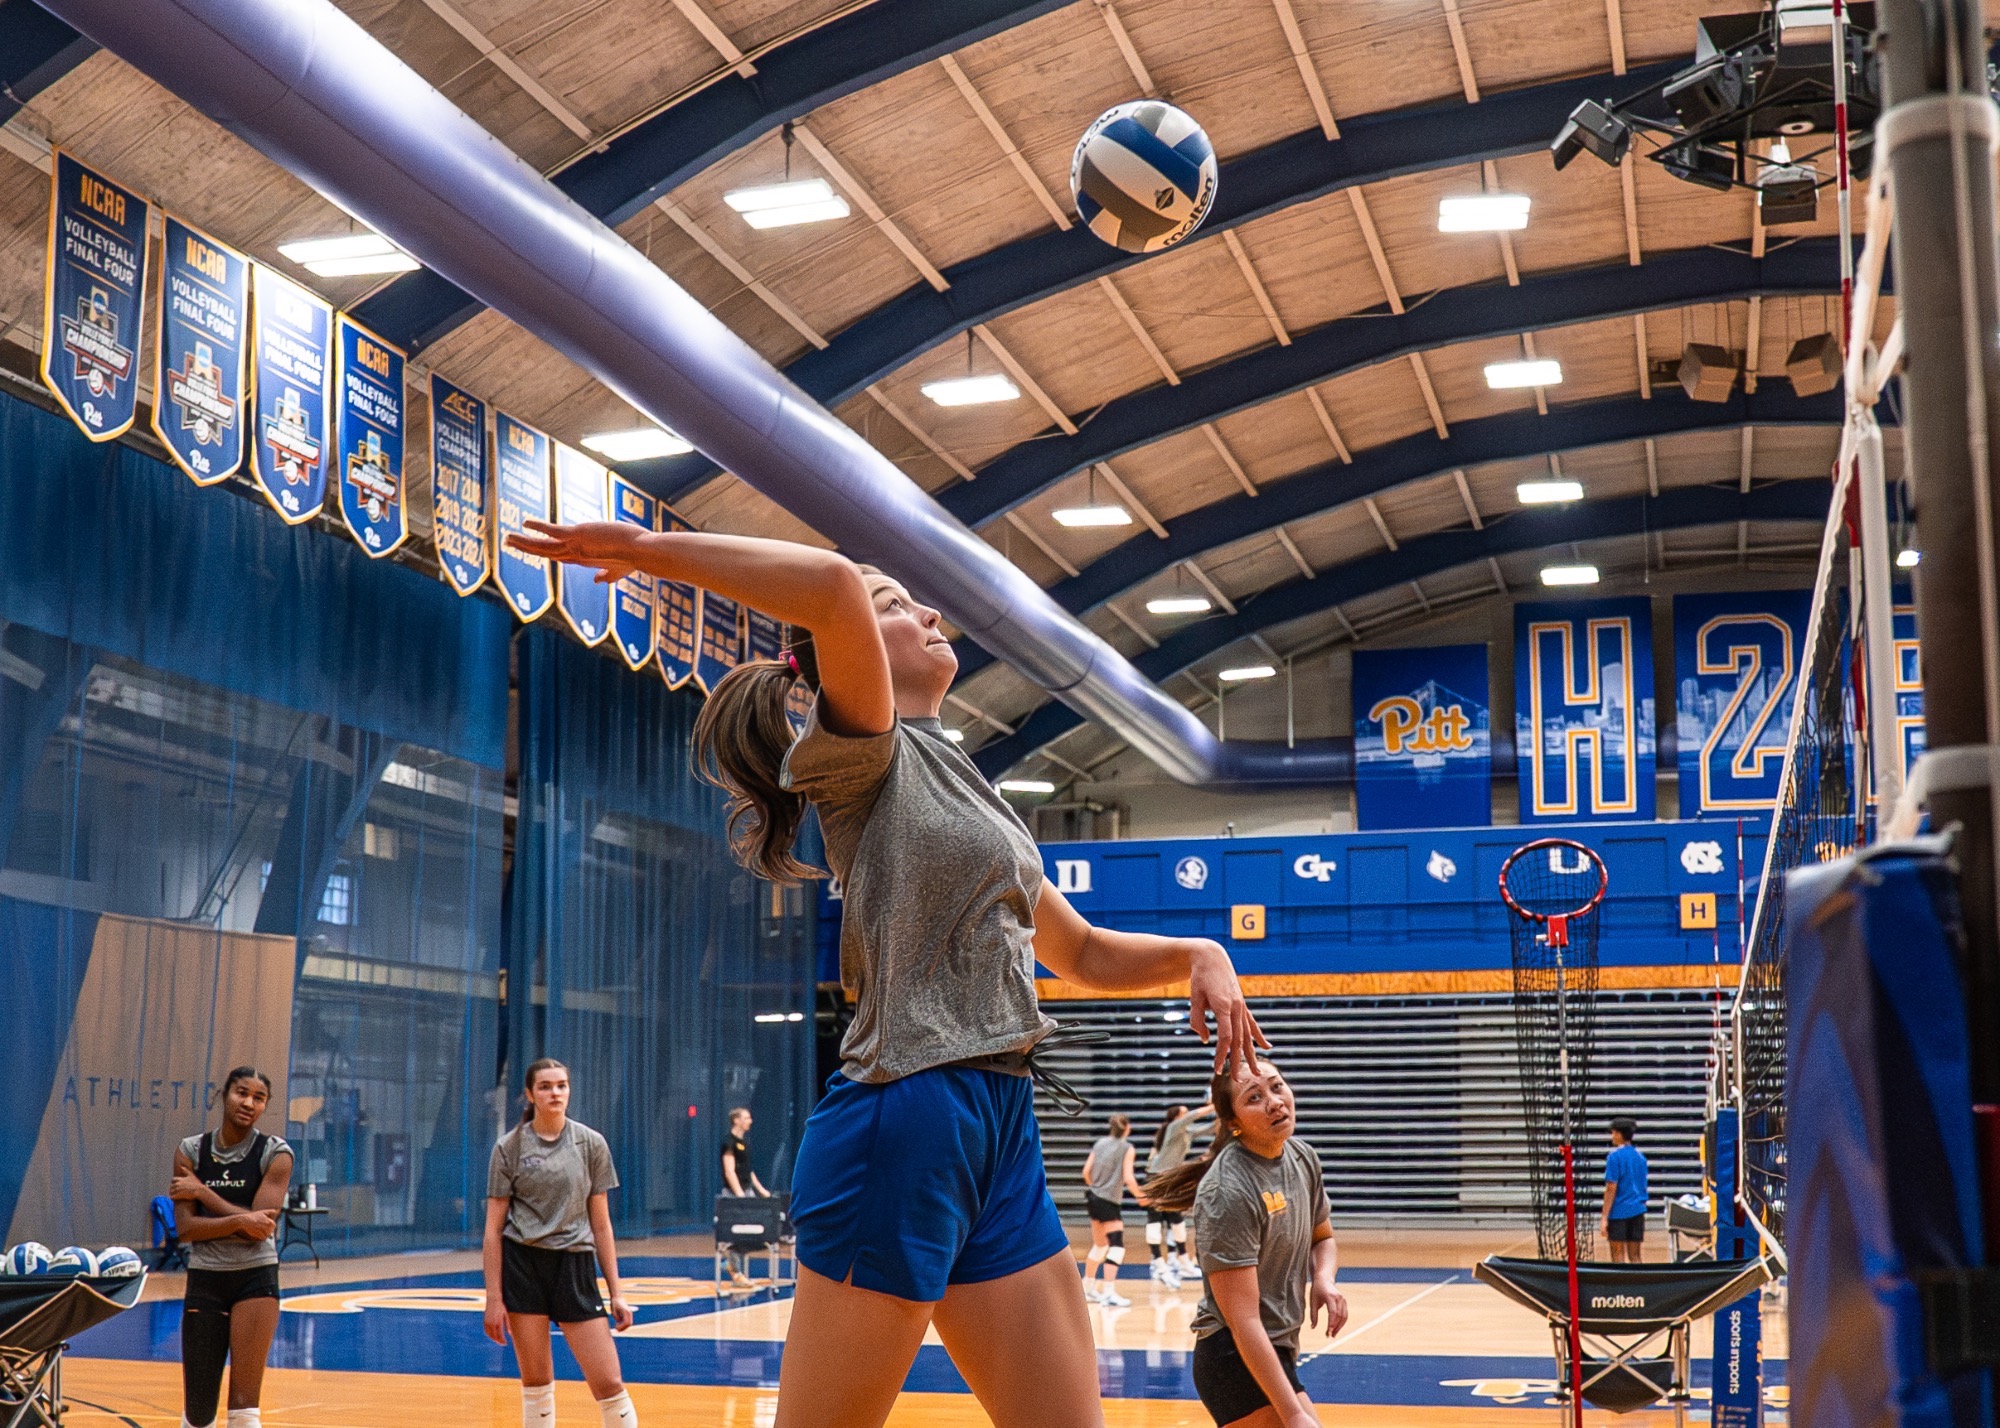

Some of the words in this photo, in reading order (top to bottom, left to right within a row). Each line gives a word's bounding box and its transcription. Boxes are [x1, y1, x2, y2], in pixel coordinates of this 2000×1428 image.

[80, 174, 126, 226] NCAA
[1162, 177, 1213, 246] molten
[64, 216, 137, 270] VOLLEYBALL
[66, 237, 103, 268] FINAL
[103, 257, 134, 287] FOUR
[186, 236, 227, 285] NCAA
[172, 276, 237, 326] VOLLEYBALL
[173, 296, 206, 325] FINAL
[206, 313, 235, 341] FOUR
[357, 337, 389, 379] NCAA
[346, 373, 400, 413] VOLLEYBALL
[348, 390, 374, 415] FINAL
[374, 405, 398, 428] FOUR
[441, 391, 477, 424] ACC
[1368, 695, 1474, 755] Pitt
[1529, 616, 1638, 816] H
[1697, 613, 1794, 812] 2
[1055, 859, 1093, 893] D
[1241, 913, 1256, 931] G
[1691, 902, 1706, 920] H
[204, 1180, 246, 1188] CATAPULT
[1591, 1294, 1645, 1308] molten
[1728, 1310, 1741, 1348] sports
[1728, 1348, 1740, 1394] imports
